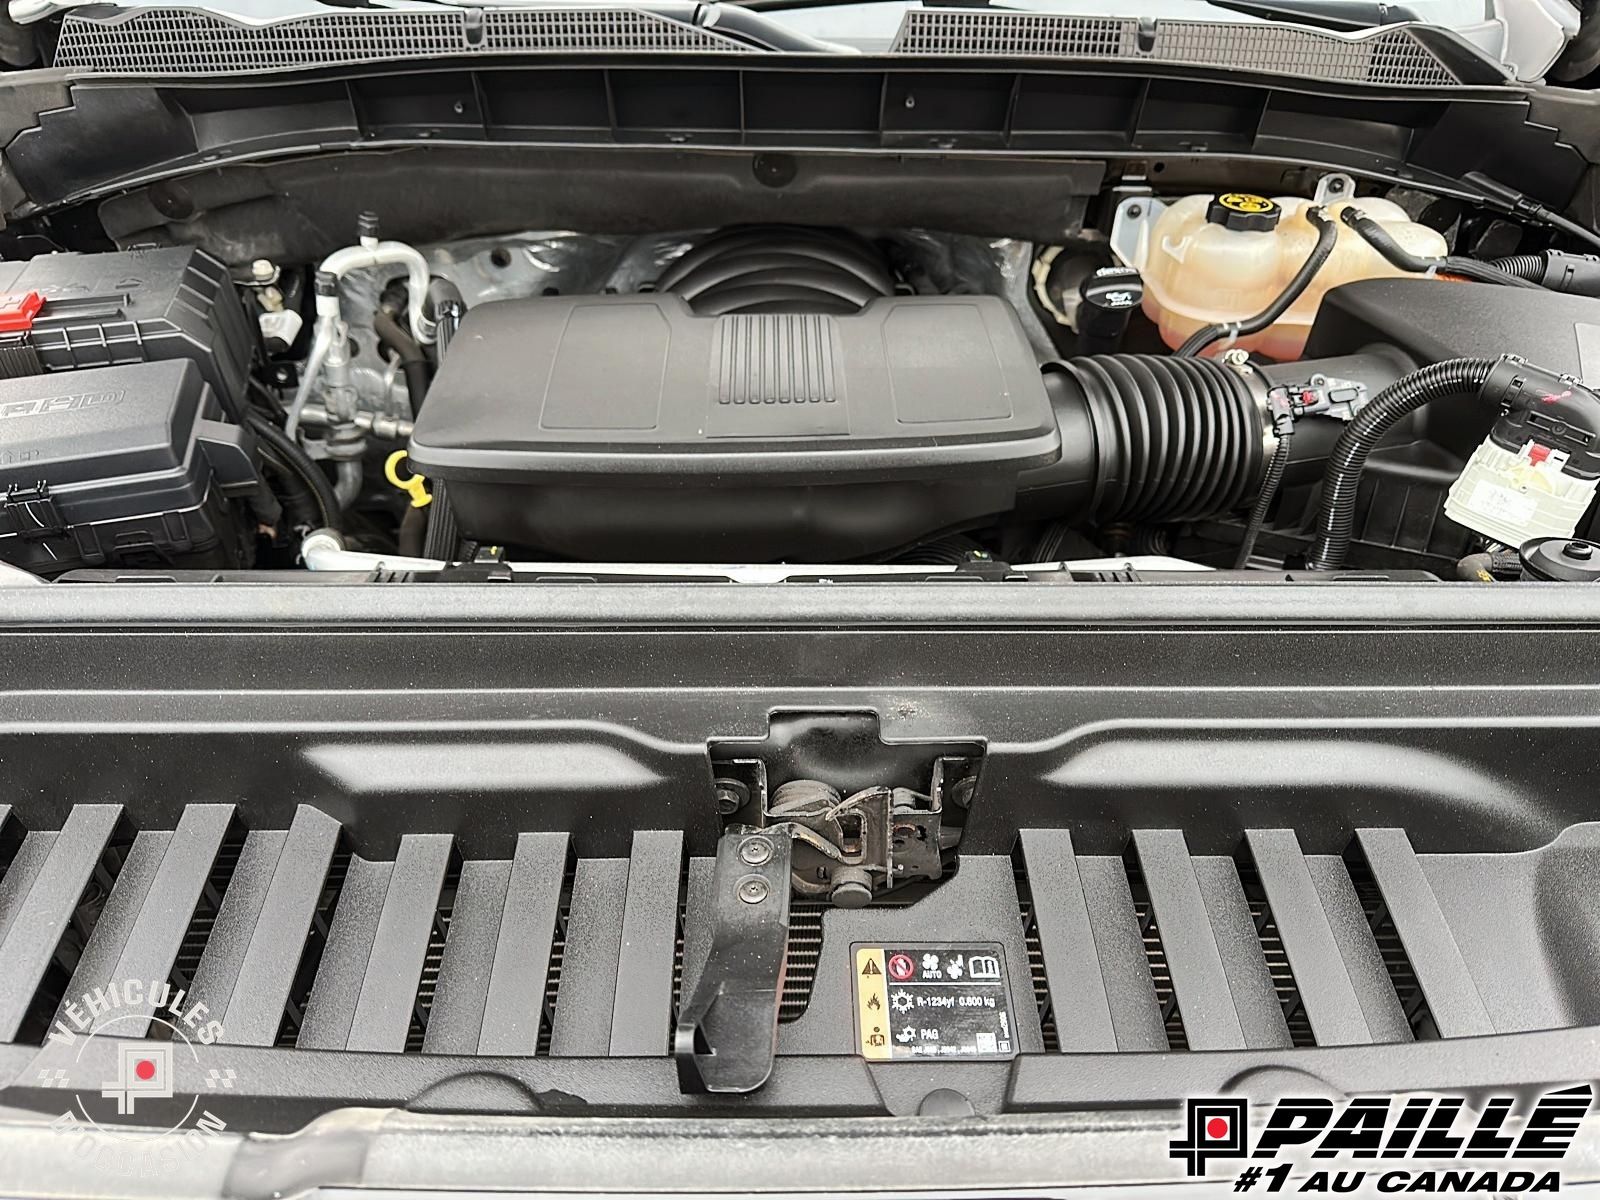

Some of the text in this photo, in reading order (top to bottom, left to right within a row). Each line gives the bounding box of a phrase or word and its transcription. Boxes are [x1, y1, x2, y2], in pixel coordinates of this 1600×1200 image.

[922, 970, 942, 979] AUTO
[984, 997, 996, 1008] kg
[921, 1029, 939, 1040] PAG
